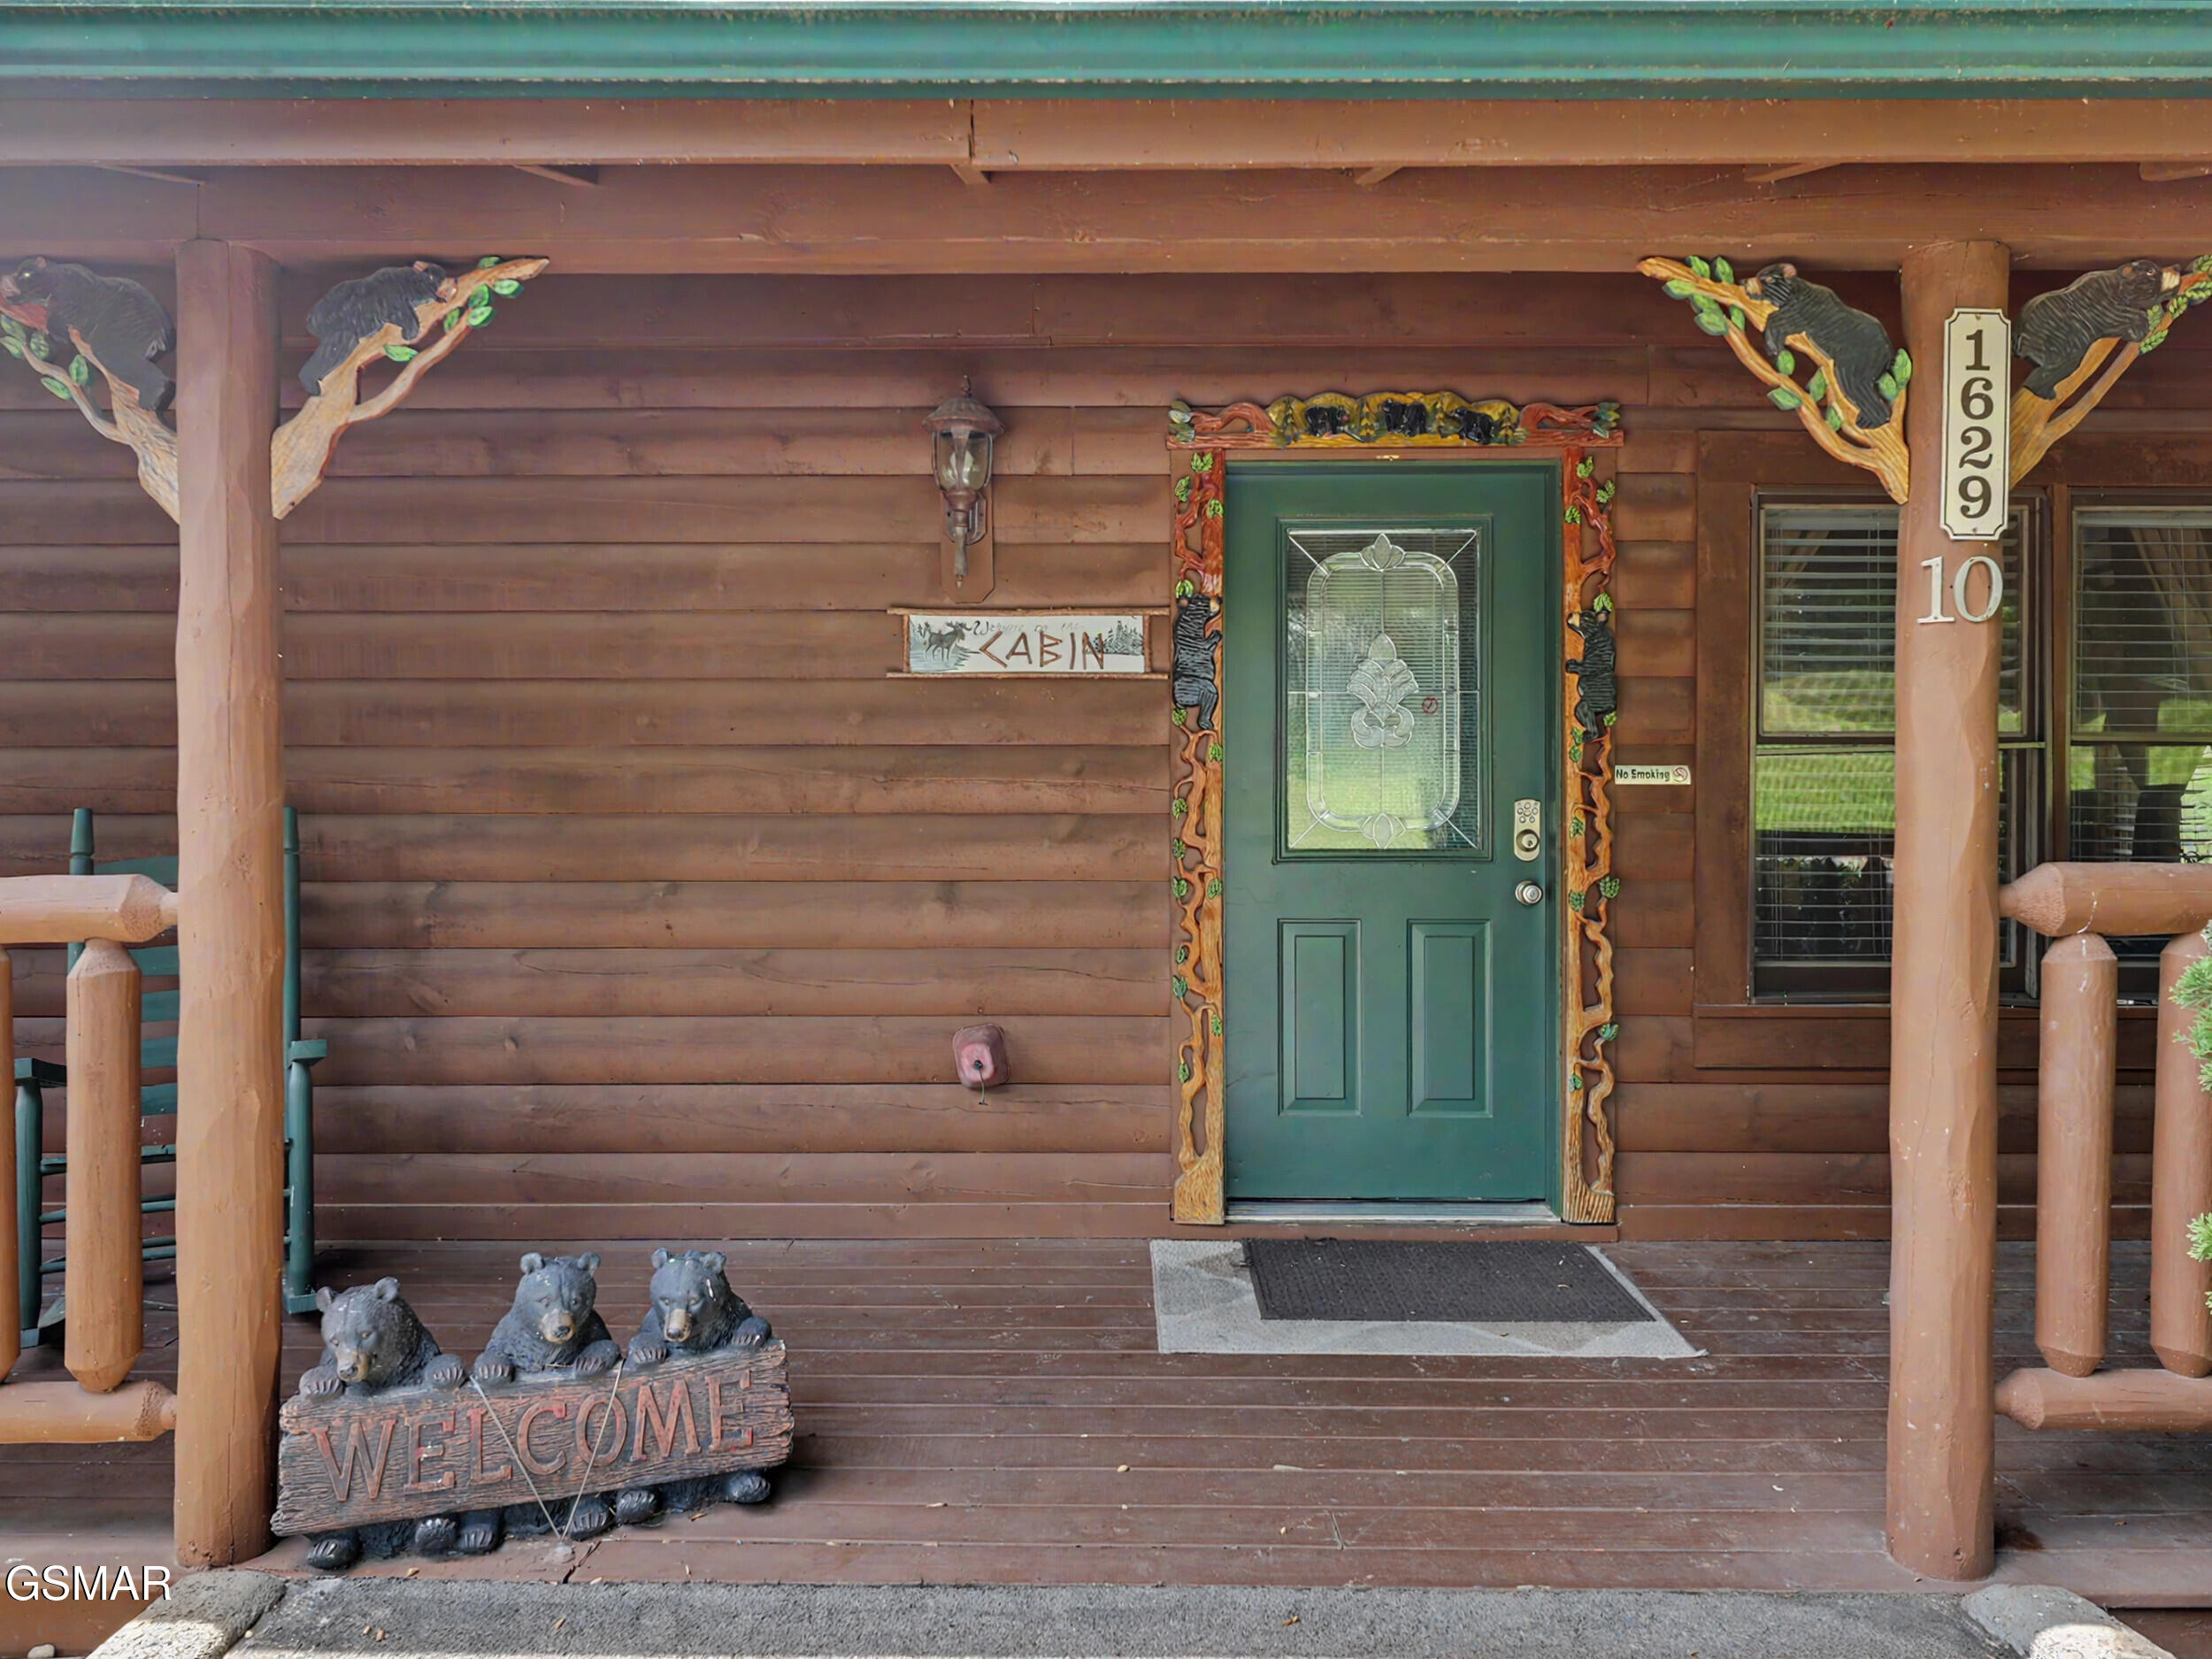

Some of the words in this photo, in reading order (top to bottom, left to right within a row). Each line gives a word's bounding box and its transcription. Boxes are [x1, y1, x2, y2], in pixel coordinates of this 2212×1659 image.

[1958, 328, 1994, 519] 1629
[1916, 556, 2004, 623] 10
[979, 631, 1103, 670] CABIN
[1616, 769, 1629, 780] No
[1631, 769, 1671, 782] Smoking
[311, 1368, 754, 1502] WELCOME
